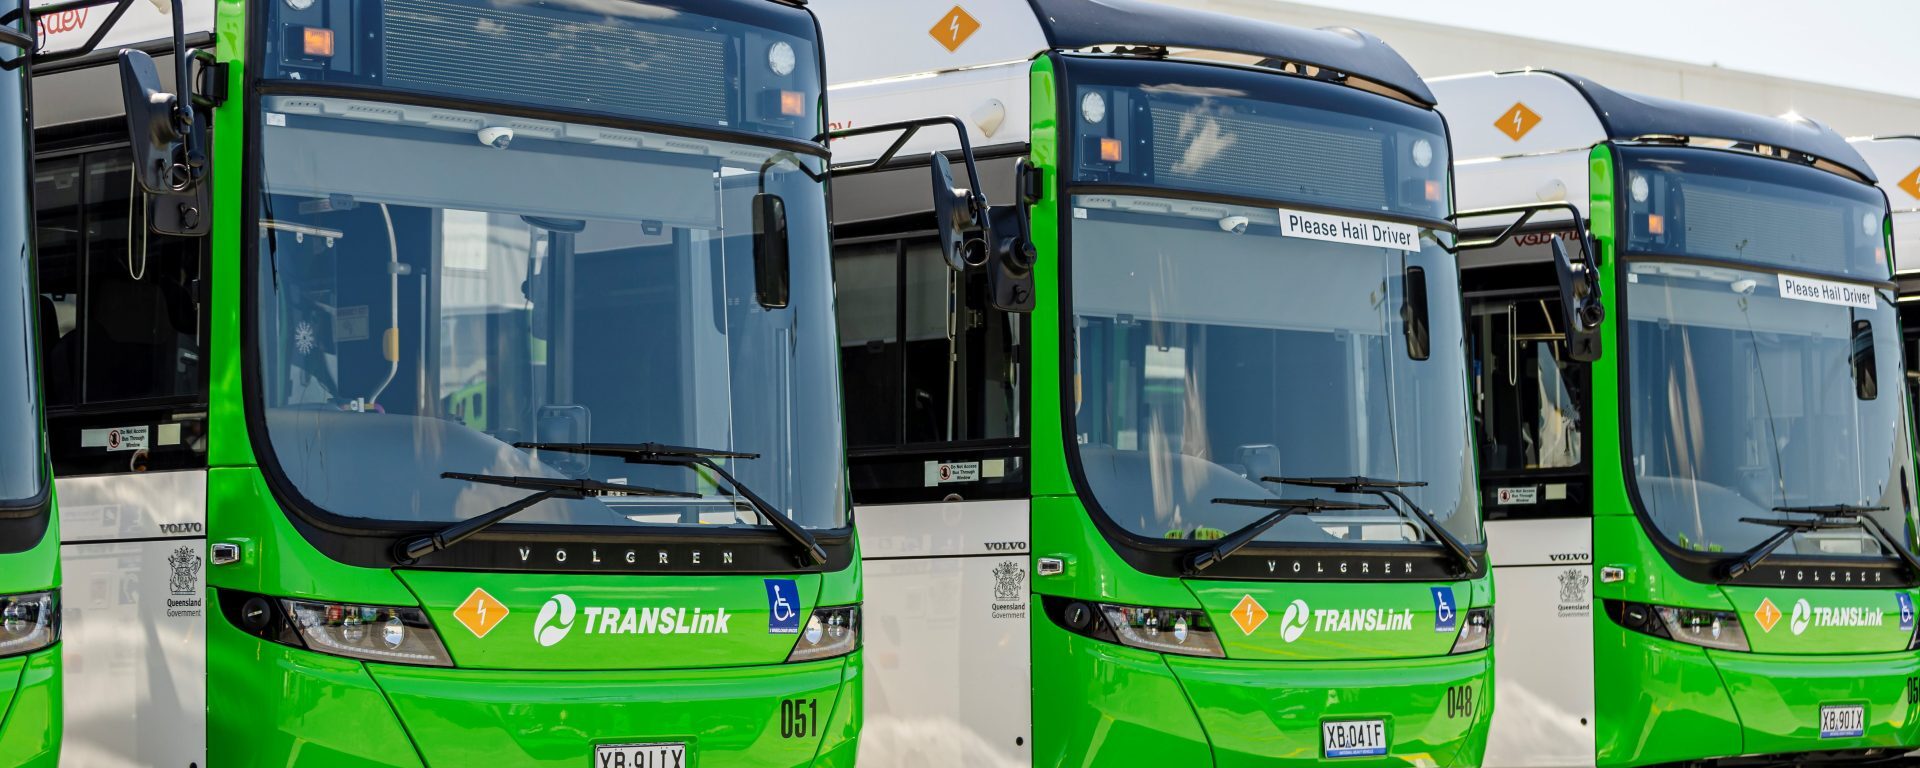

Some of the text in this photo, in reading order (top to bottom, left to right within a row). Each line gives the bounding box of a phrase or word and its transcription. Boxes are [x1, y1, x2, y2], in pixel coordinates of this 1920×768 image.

[1289, 214, 1411, 246] Please Hail Driver
[1785, 279, 1870, 305] Please Hail Driver
[159, 522, 202, 534] VOLVO
[984, 541, 1026, 551] VOLVO
[519, 548, 733, 564] VOLGREN
[1549, 553, 1589, 561] VOLVO
[1268, 562, 1412, 573] VOLGREN
[167, 598, 202, 607] Queensland
[992, 603, 1026, 611] Queensland
[167, 608, 201, 617] Government
[583, 607, 732, 634] TRANSLink
[992, 611, 1025, 619] Government
[1314, 608, 1414, 632] TRANSLink
[1813, 606, 1884, 626] TRANSLink
[1907, 677, 1920, 704] 05
[1447, 685, 1472, 719] 048
[780, 698, 817, 739] 051
